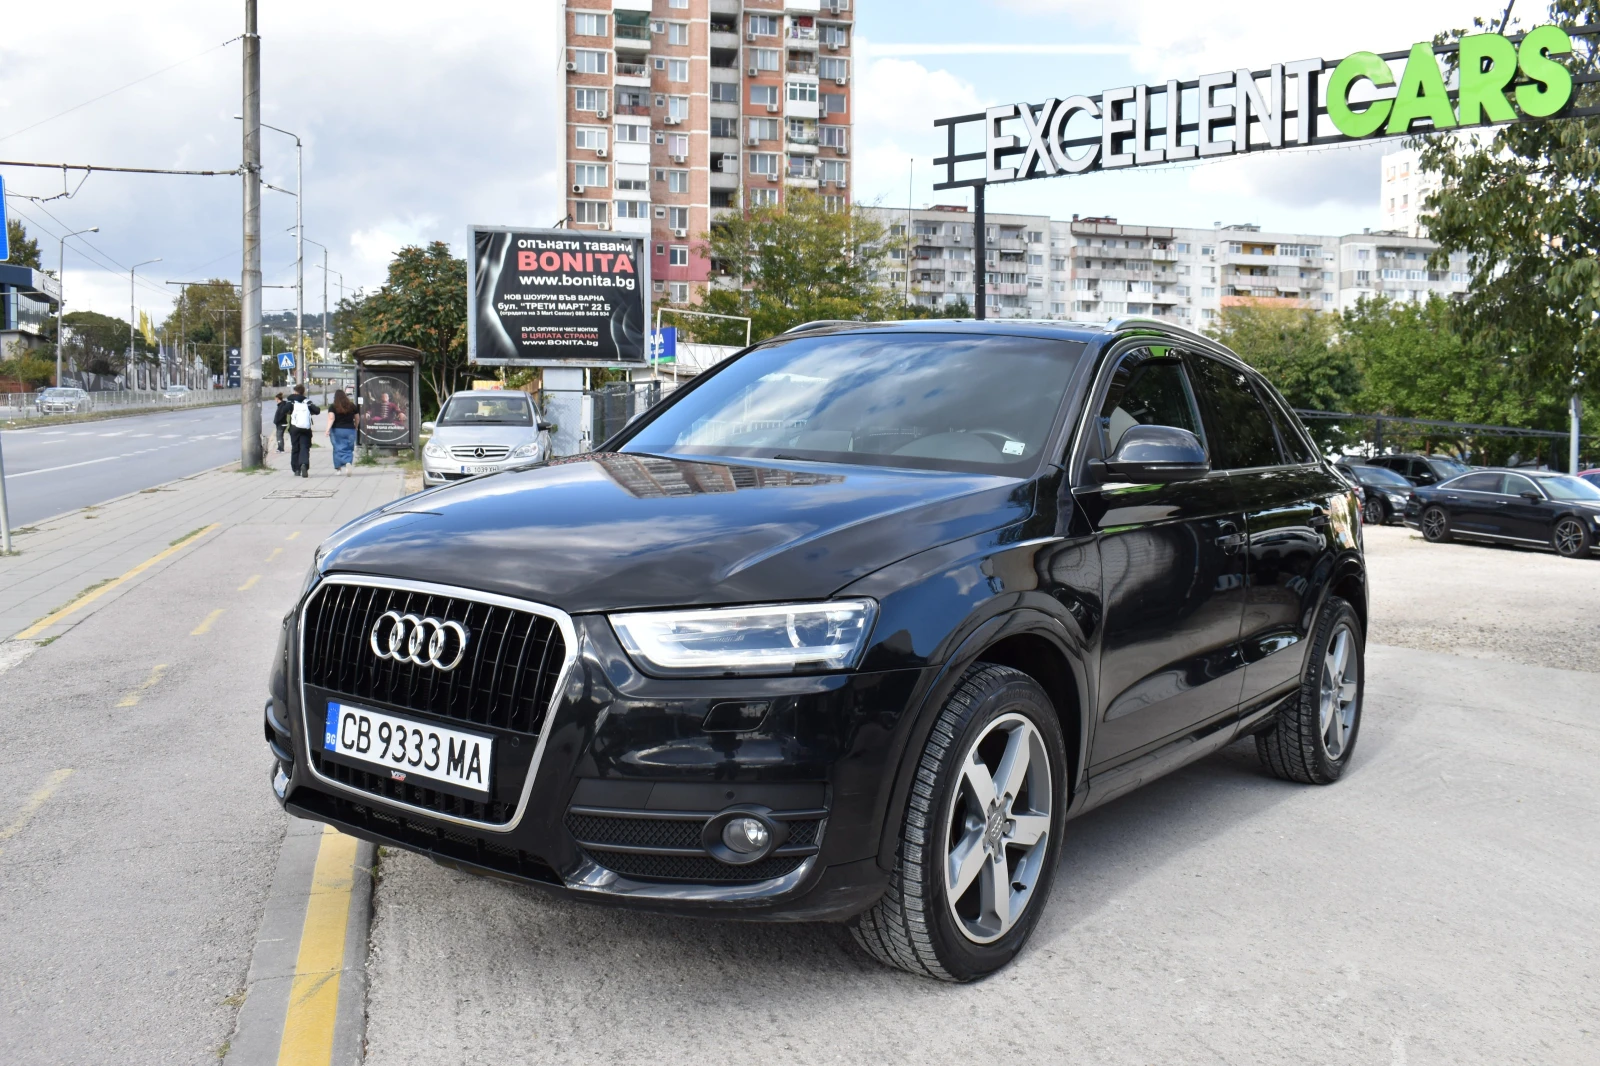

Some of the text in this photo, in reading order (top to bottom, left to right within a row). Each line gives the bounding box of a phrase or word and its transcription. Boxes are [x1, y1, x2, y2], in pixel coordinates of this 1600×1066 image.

[1326, 25, 1573, 138] CARS
[517, 239, 633, 252] опънати тавани
[517, 250, 635, 274] BONITA
[519, 274, 636, 291] www.bonita.bg
[503, 293, 522, 301] НОВ
[523, 293, 558, 301] ШОУРУМ
[577, 294, 605, 302] ВАРНА
[497, 302, 519, 311] бул.
[591, 303, 602, 311] 22
[604, 303, 612, 311] Б
[529, 332, 562, 340] ЦЯЛАТА
[522, 339, 599, 347] www.BONITA.bg
[325, 732, 336, 745] BG
[341, 712, 482, 784] CB 9333 MA
